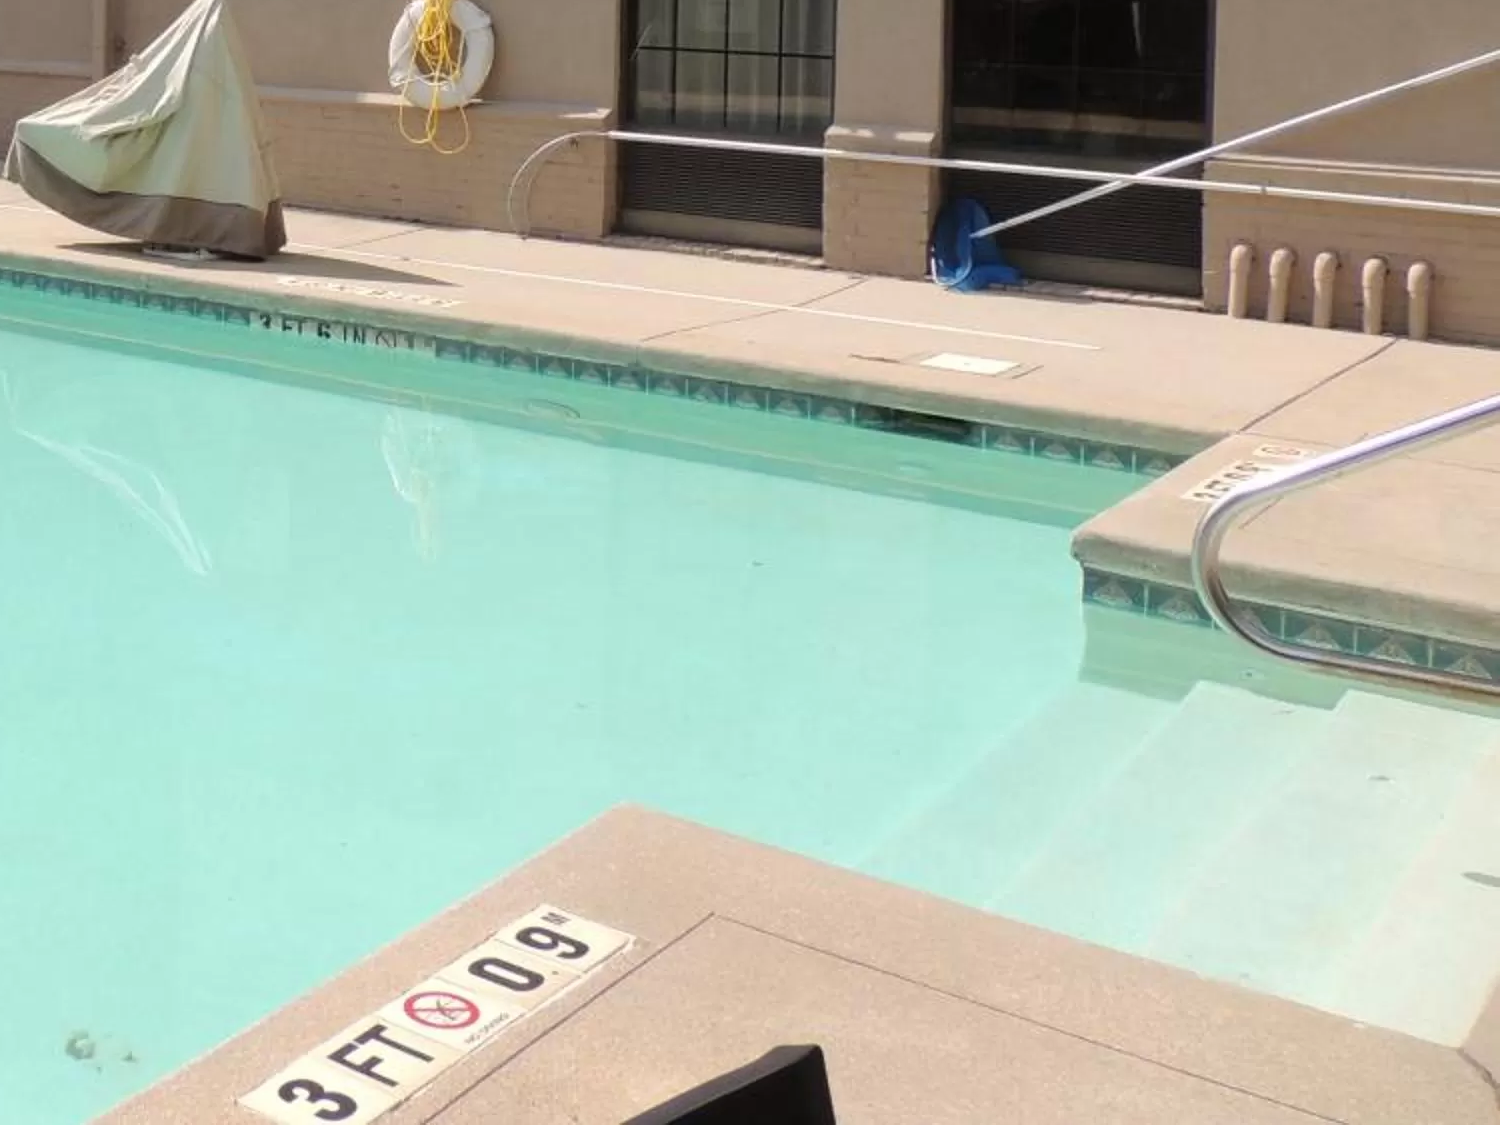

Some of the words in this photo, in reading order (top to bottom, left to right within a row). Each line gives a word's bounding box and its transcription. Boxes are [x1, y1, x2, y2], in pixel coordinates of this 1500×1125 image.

[282, 318, 304, 336] FT
[342, 325, 366, 345] IN
[277, 1077, 358, 1122] 3
[326, 1023, 436, 1088] FT
